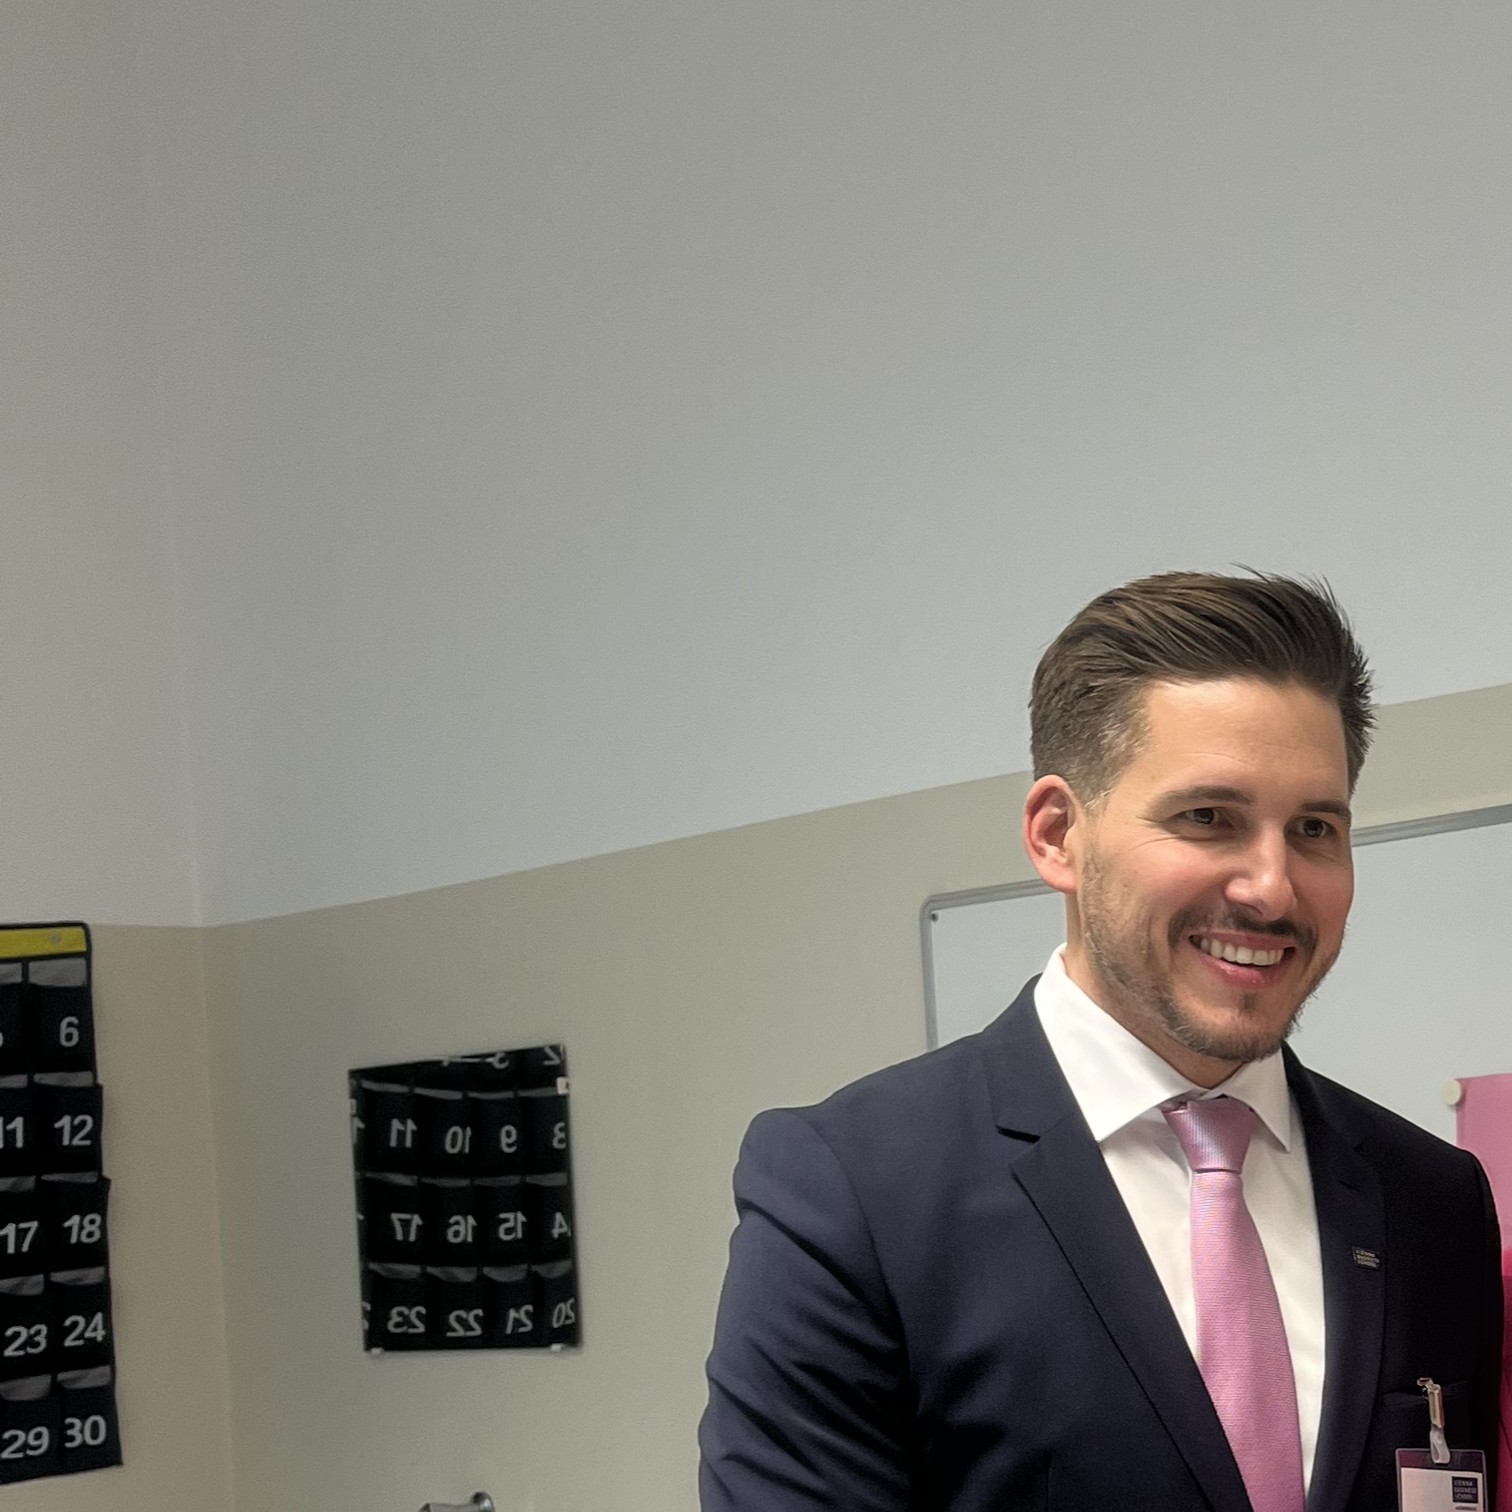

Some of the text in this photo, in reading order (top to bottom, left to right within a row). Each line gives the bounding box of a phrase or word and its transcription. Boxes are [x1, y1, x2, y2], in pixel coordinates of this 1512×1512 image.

[59, 1016, 79, 1047] 6
[54, 1114, 94, 1146] 12
[0, 1213, 102, 1254] 17 18
[3, 1312, 106, 1358] 23 24
[0, 1415, 107, 1460] 29 30
